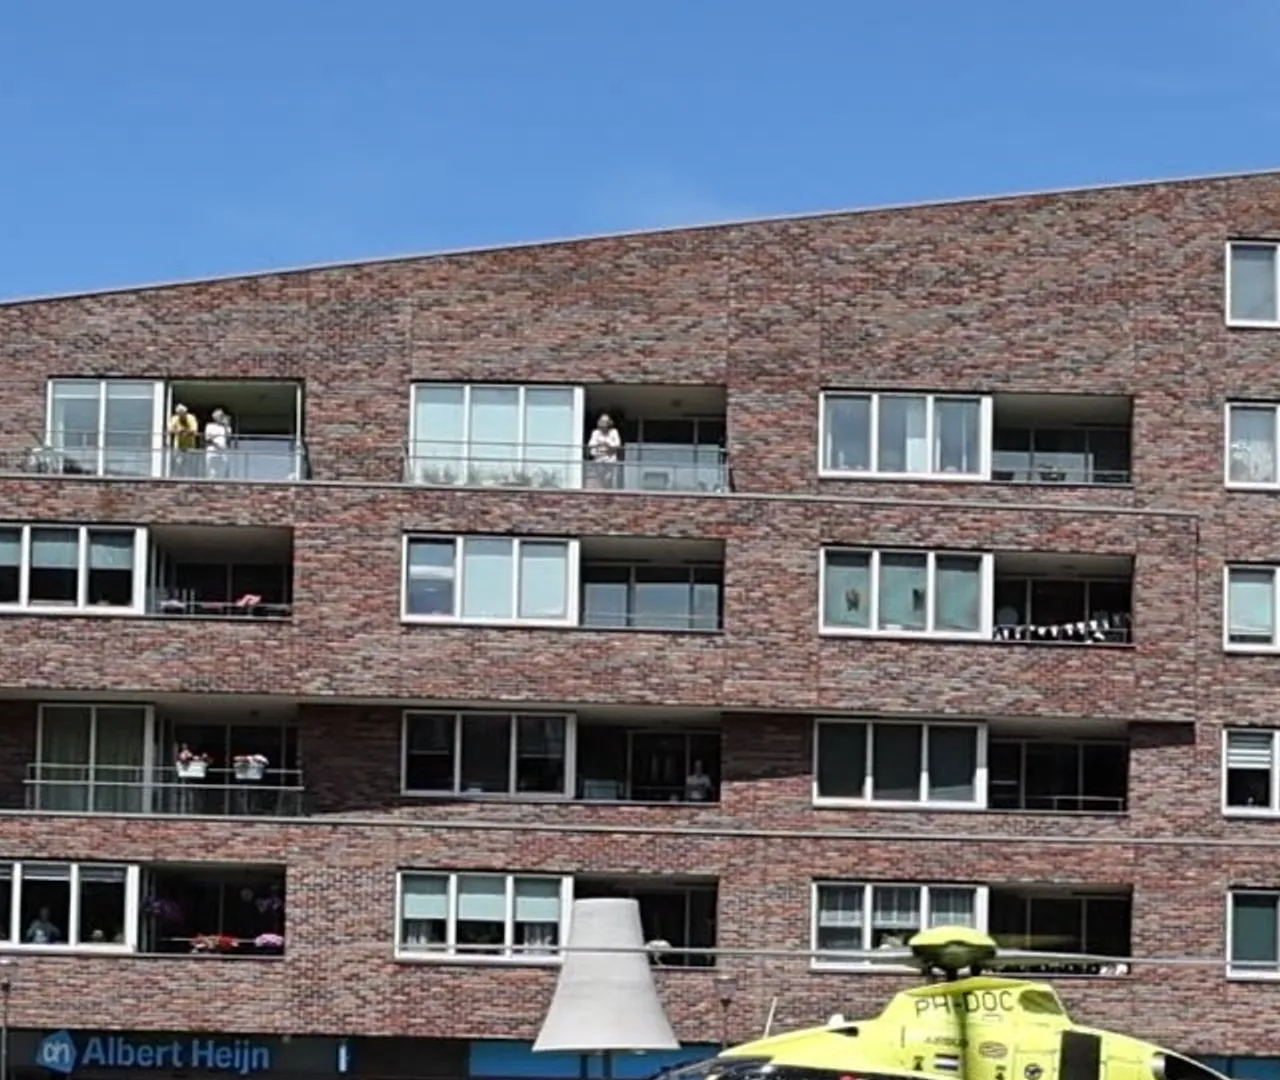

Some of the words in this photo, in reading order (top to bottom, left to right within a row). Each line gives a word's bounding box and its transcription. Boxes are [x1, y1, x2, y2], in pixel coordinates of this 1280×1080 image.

[915, 990, 1014, 1018] PH-DOC
[82, 1037, 183, 1067] Albert
[192, 1039, 270, 1074] Heijn
